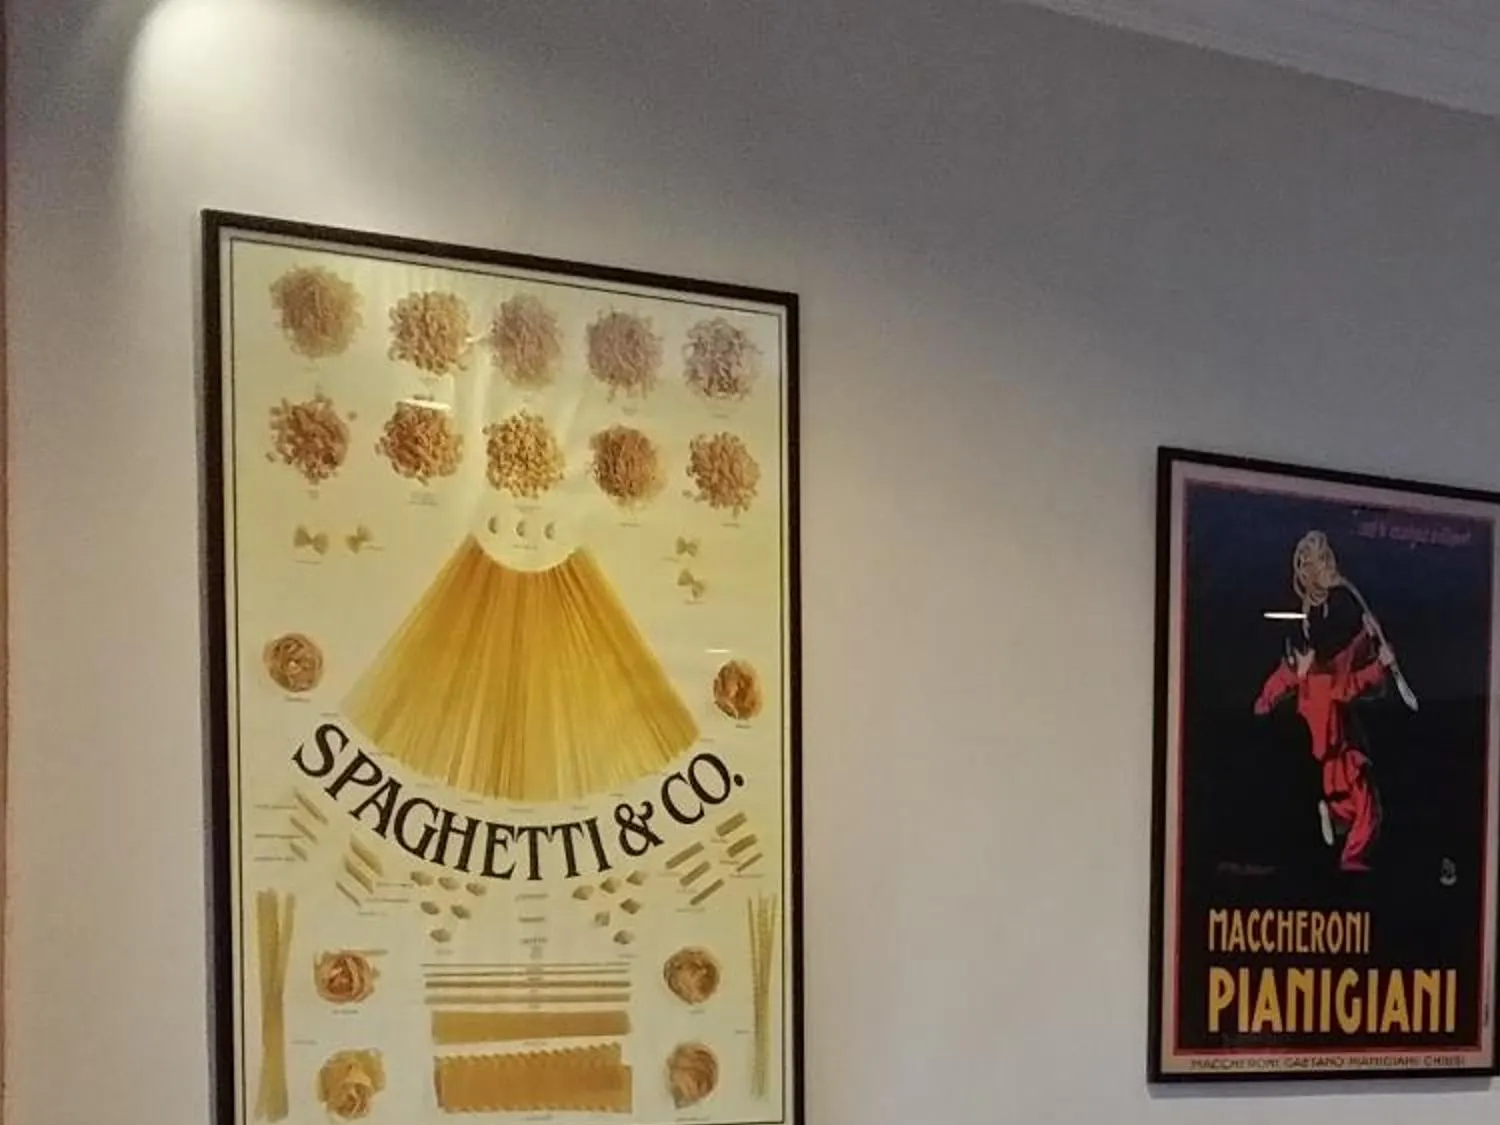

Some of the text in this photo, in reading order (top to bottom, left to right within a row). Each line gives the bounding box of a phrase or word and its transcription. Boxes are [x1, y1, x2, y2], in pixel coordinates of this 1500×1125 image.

[292, 722, 745, 881] SPAGHETTI & CO.
[1208, 908, 1371, 954] MACCHERONI
[1208, 967, 1457, 1033] PIANIGIANI
